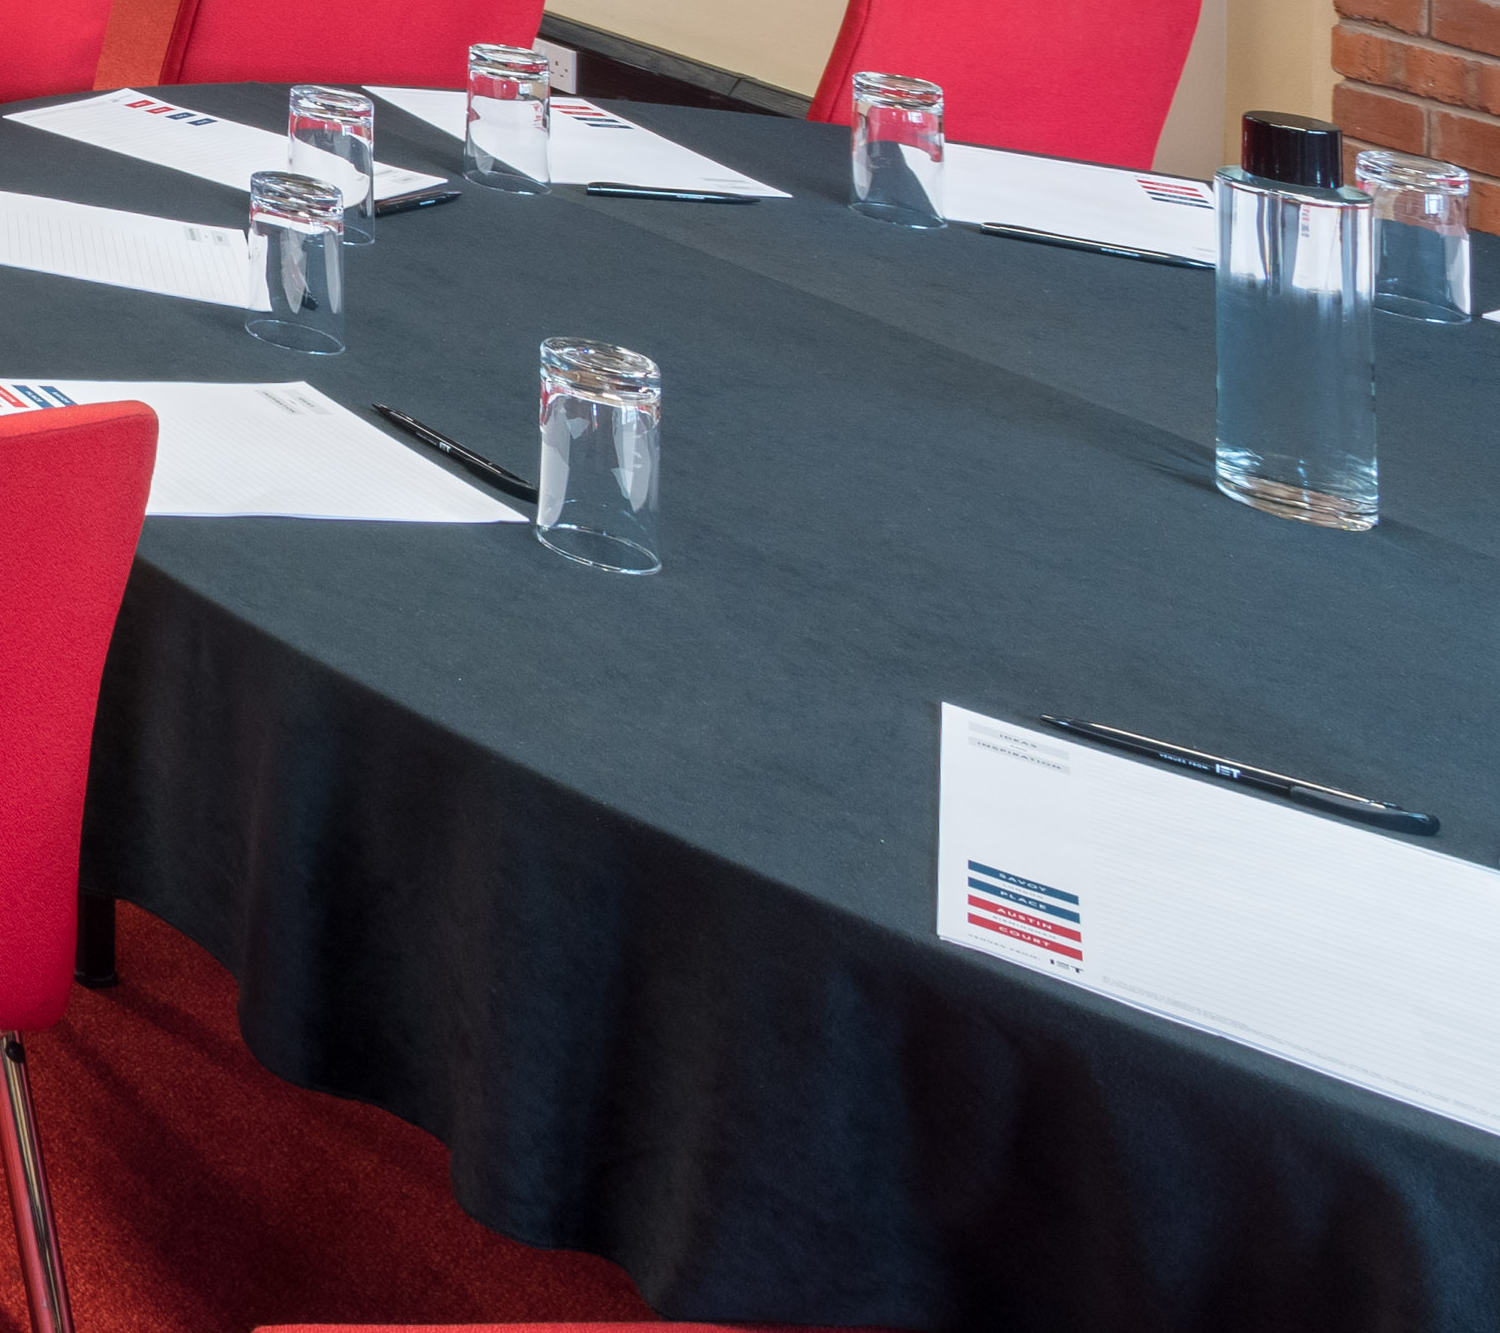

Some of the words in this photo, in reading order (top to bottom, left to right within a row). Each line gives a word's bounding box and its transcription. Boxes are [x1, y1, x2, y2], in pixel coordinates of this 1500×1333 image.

[1215, 763, 1242, 779] IET
[998, 872, 1047, 892] SAVOY
[999, 890, 1047, 910] PLACE
[996, 907, 1052, 930] AUSTIN
[998, 925, 1051, 947] COURT
